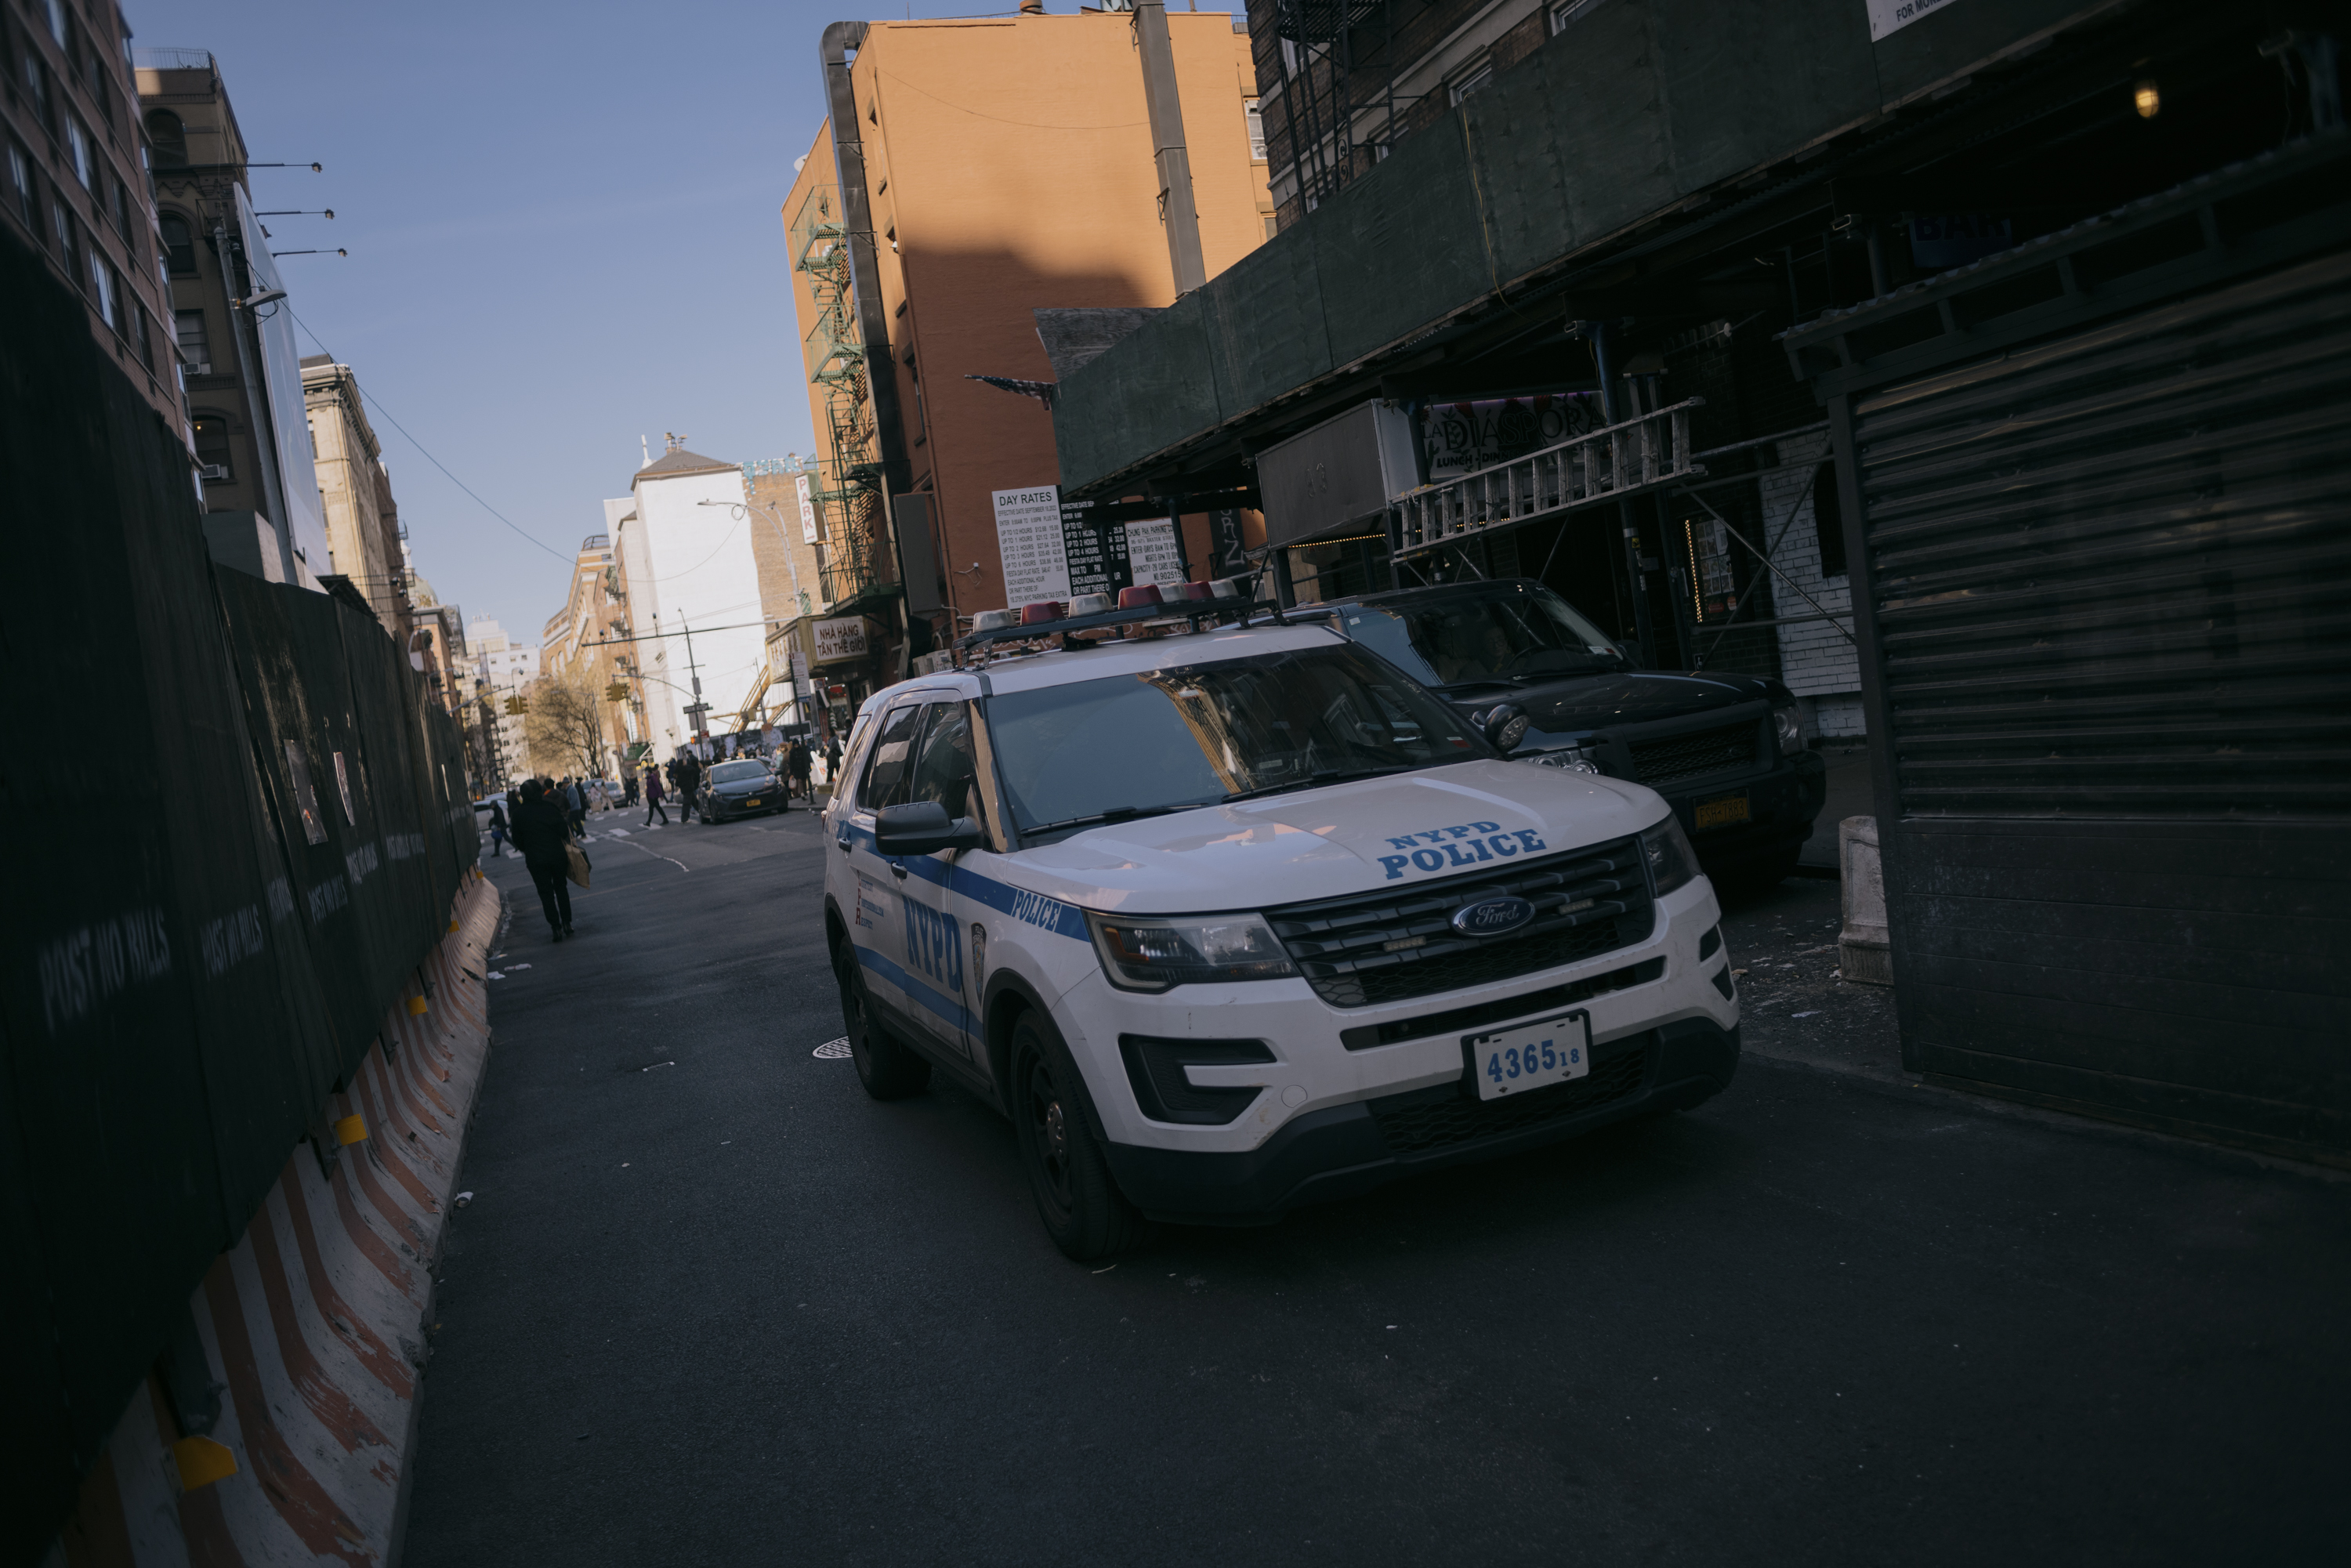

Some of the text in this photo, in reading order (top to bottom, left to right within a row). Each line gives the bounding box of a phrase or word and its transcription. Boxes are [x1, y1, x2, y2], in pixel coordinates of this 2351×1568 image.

[1896, 3, 1914, 22] FOR
[1441, 406, 1607, 451] DIÁSPORA
[1436, 447, 1525, 468] LUNCH DINNER
[799, 479, 814, 530] PARK
[999, 491, 1052, 506] DAY RATES
[1025, 505, 1045, 514] SEPTEMBER
[1128, 528, 1140, 537] CHUNG
[1150, 524, 1167, 533] PARKING
[1083, 538, 1099, 546] HOURS
[1144, 545, 1154, 553] DAYS
[1070, 564, 1102, 576] MAX TO PM
[1133, 564, 1151, 574] CAPACITY
[1160, 570, 1182, 581] 902515
[1071, 576, 1084, 585] EACH
[1084, 574, 1108, 584] ADDITIONAL
[1073, 586, 1080, 595] OR
[1080, 585, 1091, 594] PART
[1091, 584, 1106, 593] THERE
[820, 622, 859, 640] NHÀ HÀNG
[817, 641, 832, 656] TÂN
[1722, 800, 1744, 820] 7883
[1385, 821, 1501, 850] NYPD
[1377, 828, 1547, 880] POLICE
[1012, 889, 1061, 932] POLICE
[1476, 903, 1520, 927] Ford
[198, 903, 264, 982] POST NO BILLS
[903, 893, 963, 993] NYPD
[40, 905, 171, 1038] POST NO BILLS
[1487, 1039, 1580, 1083] 4365 18
